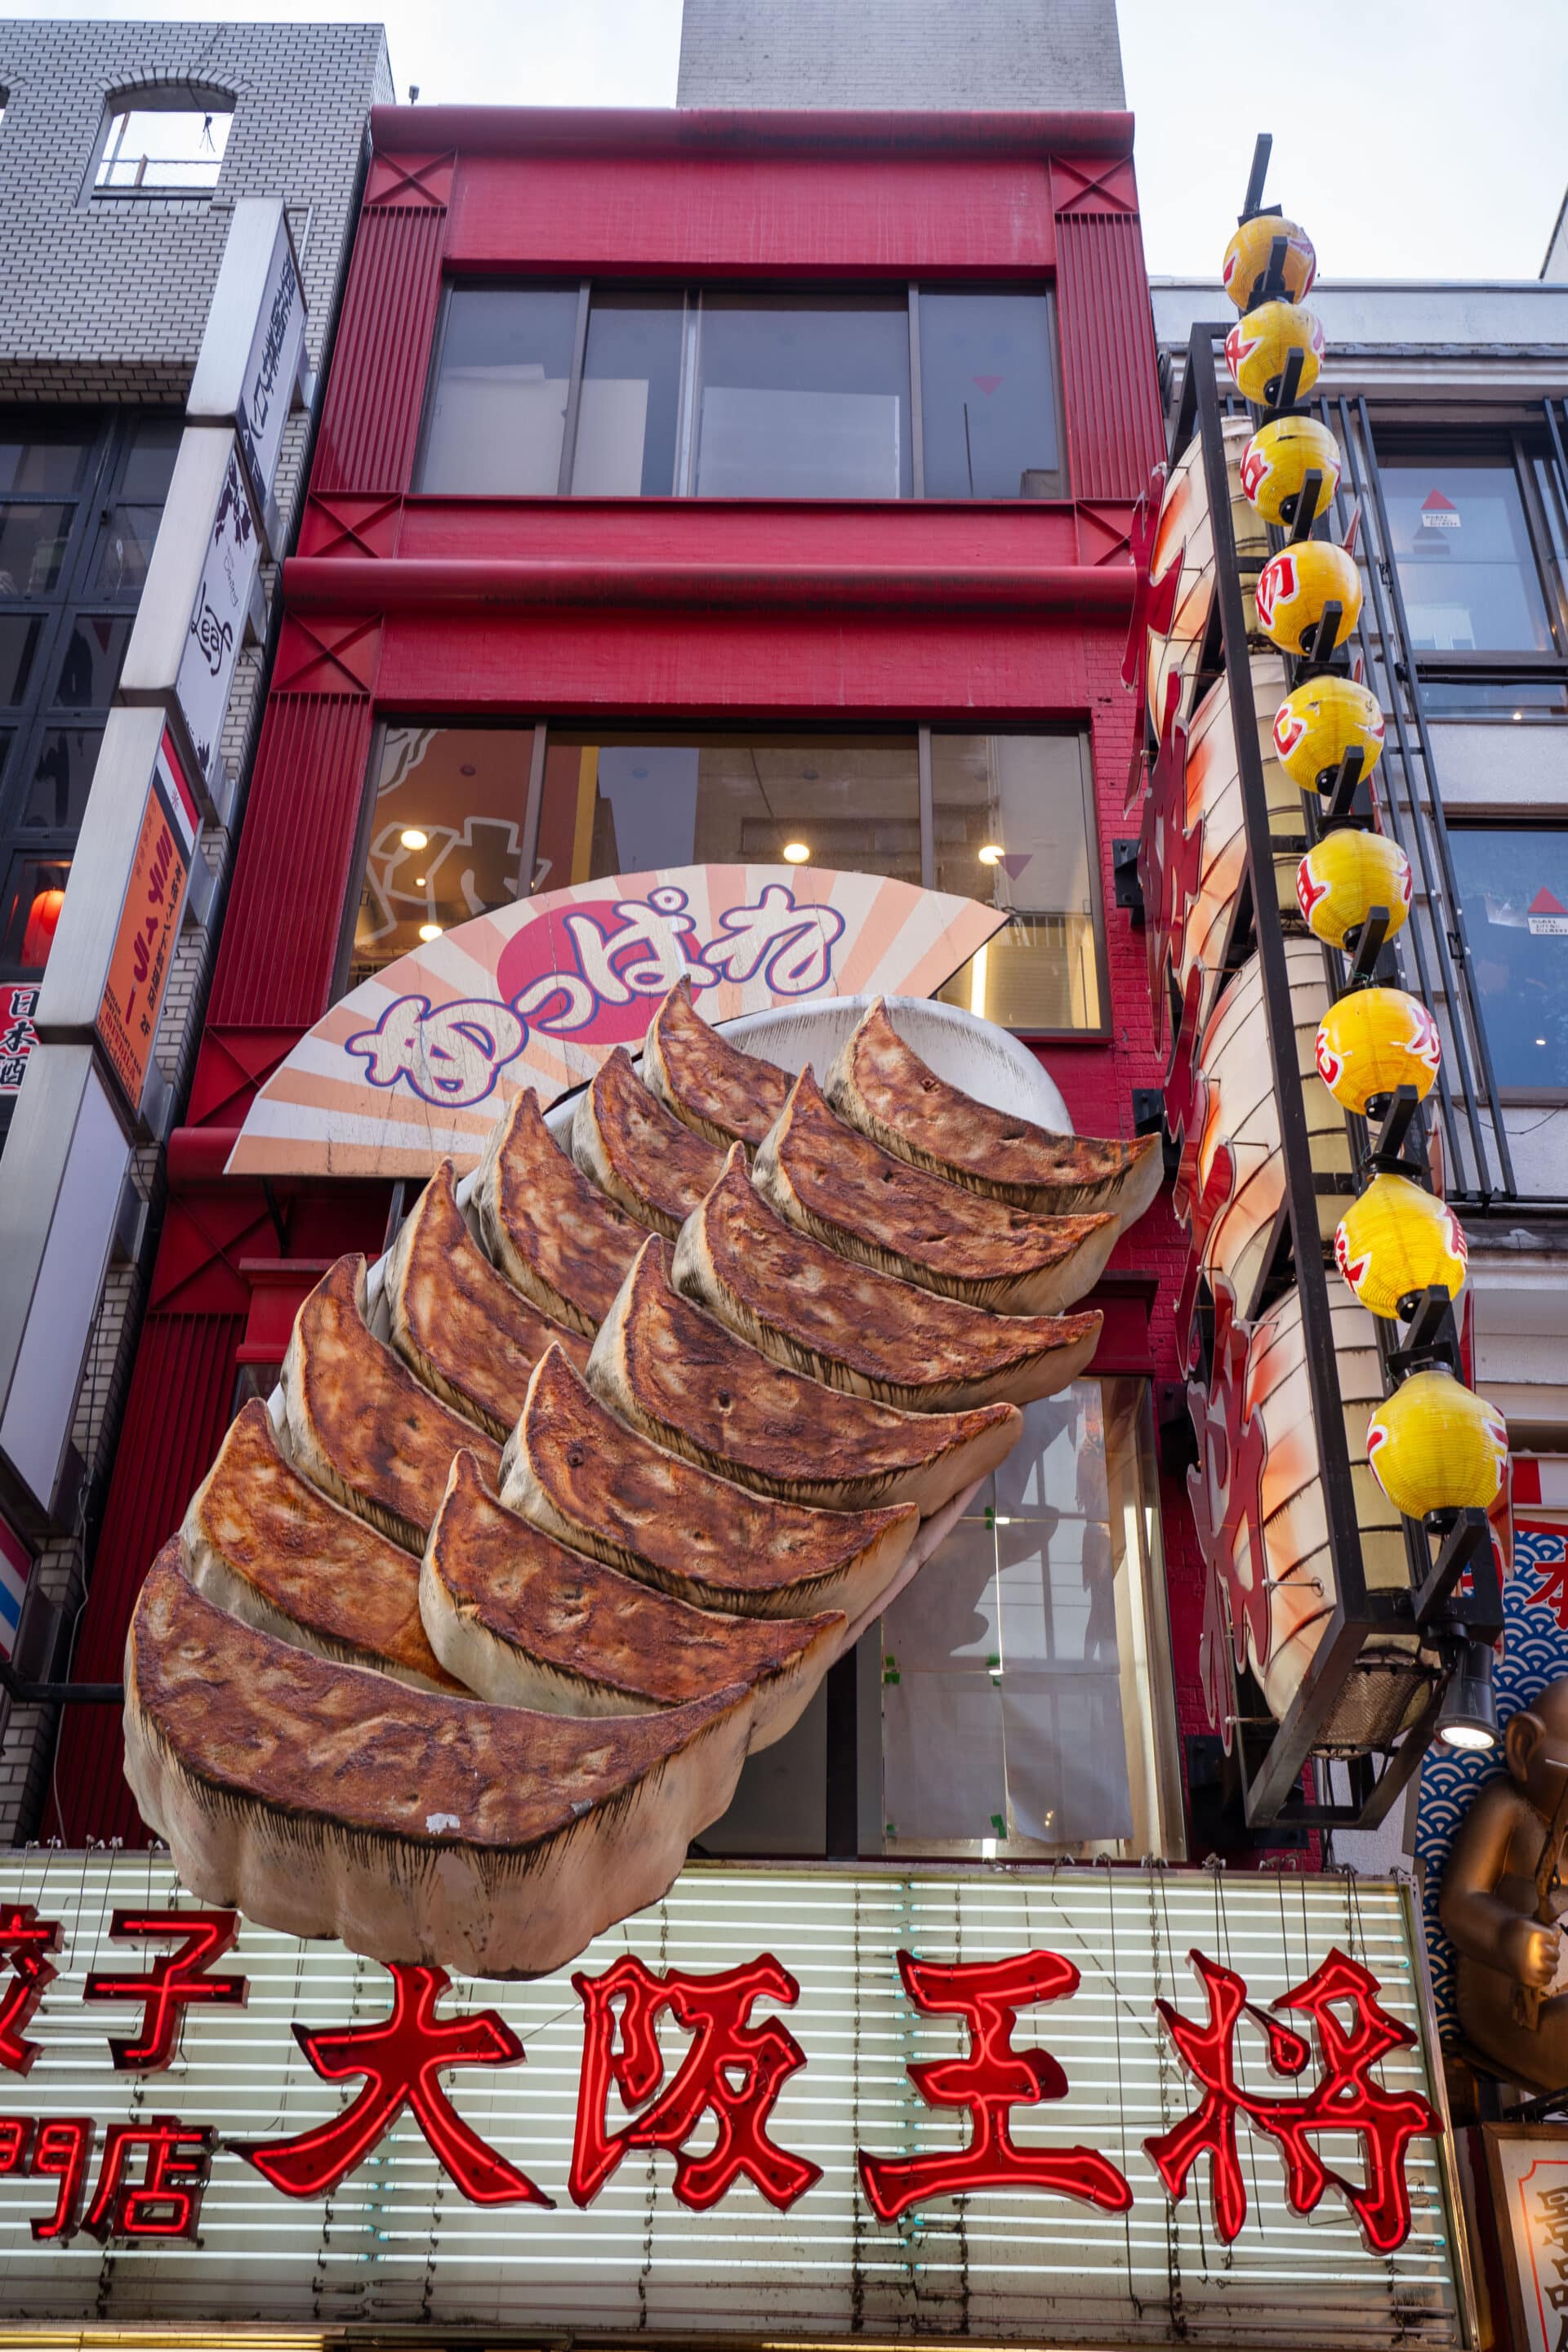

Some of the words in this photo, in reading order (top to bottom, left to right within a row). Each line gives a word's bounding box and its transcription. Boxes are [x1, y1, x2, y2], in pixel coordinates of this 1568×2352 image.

[190, 581, 233, 676] Leaf
[126, 822, 173, 1025] ミティラー
[224, 1947, 1446, 2256] 大阪王将
